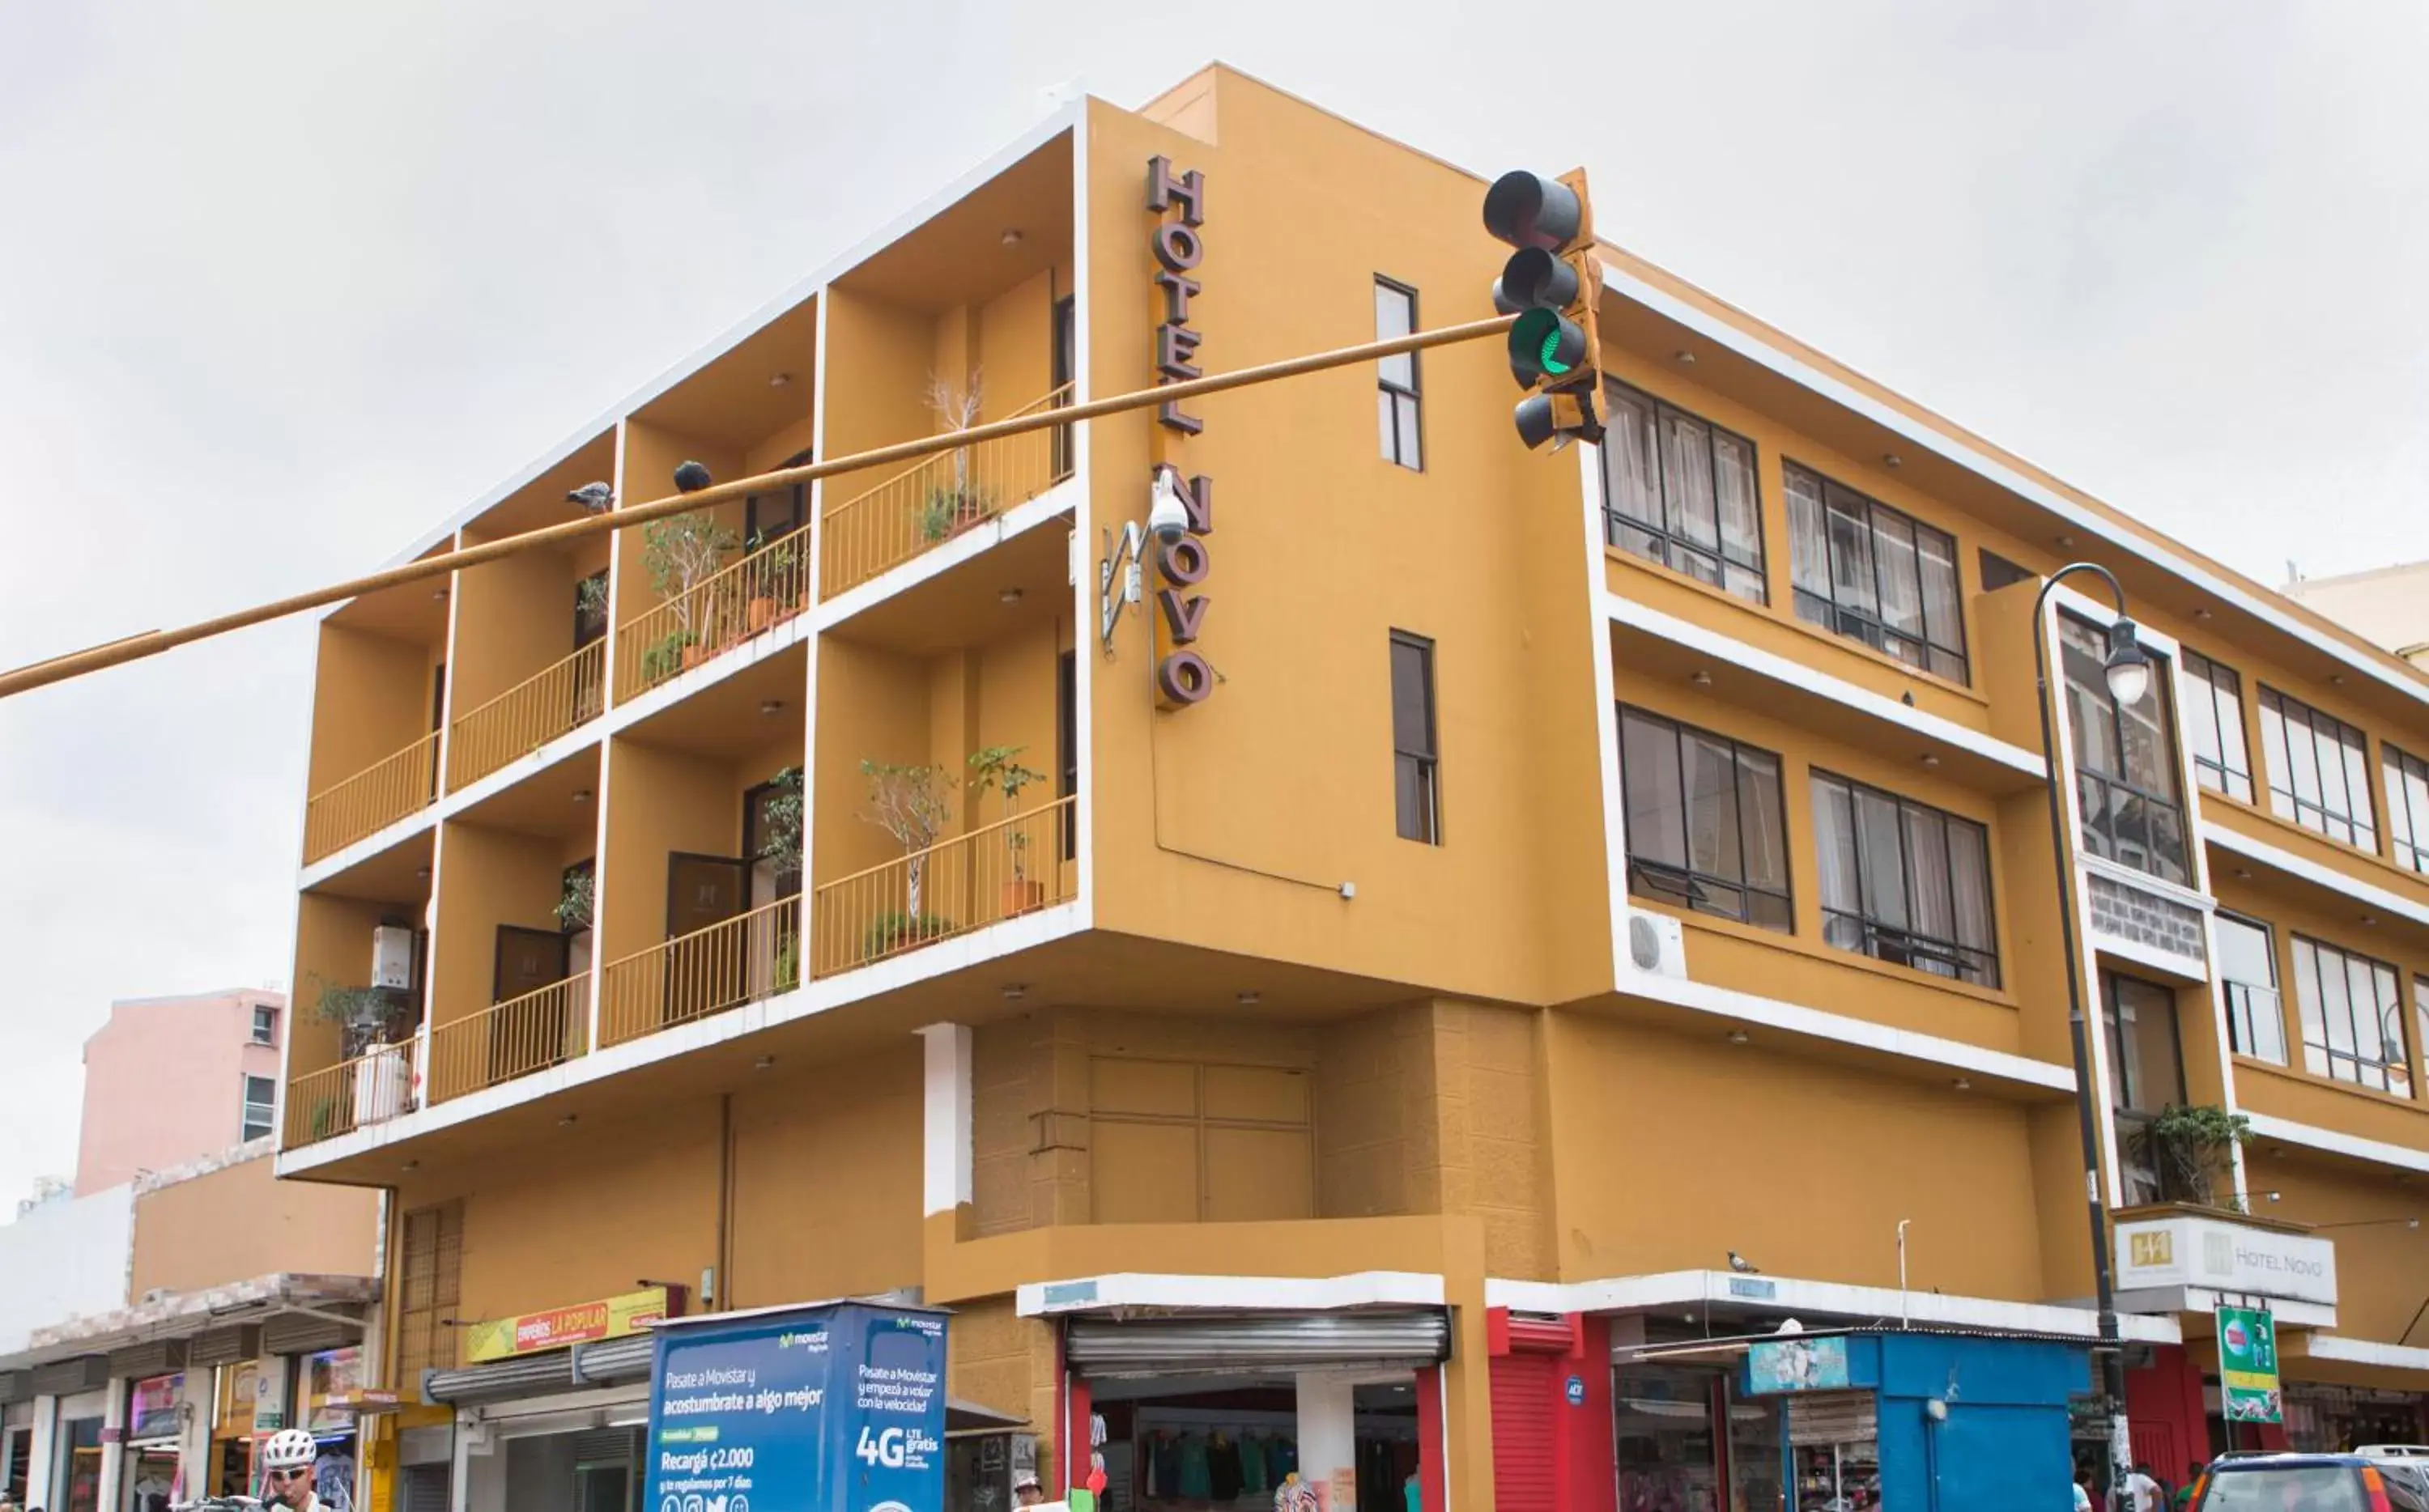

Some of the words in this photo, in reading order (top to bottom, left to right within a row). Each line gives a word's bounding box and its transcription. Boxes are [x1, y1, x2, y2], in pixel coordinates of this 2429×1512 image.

[1147, 155, 1205, 436] HOTEL
[1153, 462, 1212, 705] NOVO
[2235, 1247, 2280, 1273] HOTEL
[2284, 1255, 2323, 1277] NOVO
[666, 1371, 697, 1389] Pasate
[705, 1368, 747, 1385] Movistar
[859, 1364, 889, 1379] Pasate
[897, 1368, 938, 1383] Movistar
[664, 1391, 744, 1416] acostumbrate
[746, 1394, 754, 1409] a
[755, 1388, 783, 1414] algo
[785, 1385, 823, 1412] mejor
[857, 1398, 874, 1408] con
[883, 1398, 927, 1412] velocidad
[856, 1425, 905, 1468] 4G
[906, 1429, 922, 1439] LTE
[906, 1437, 938, 1453] gratis
